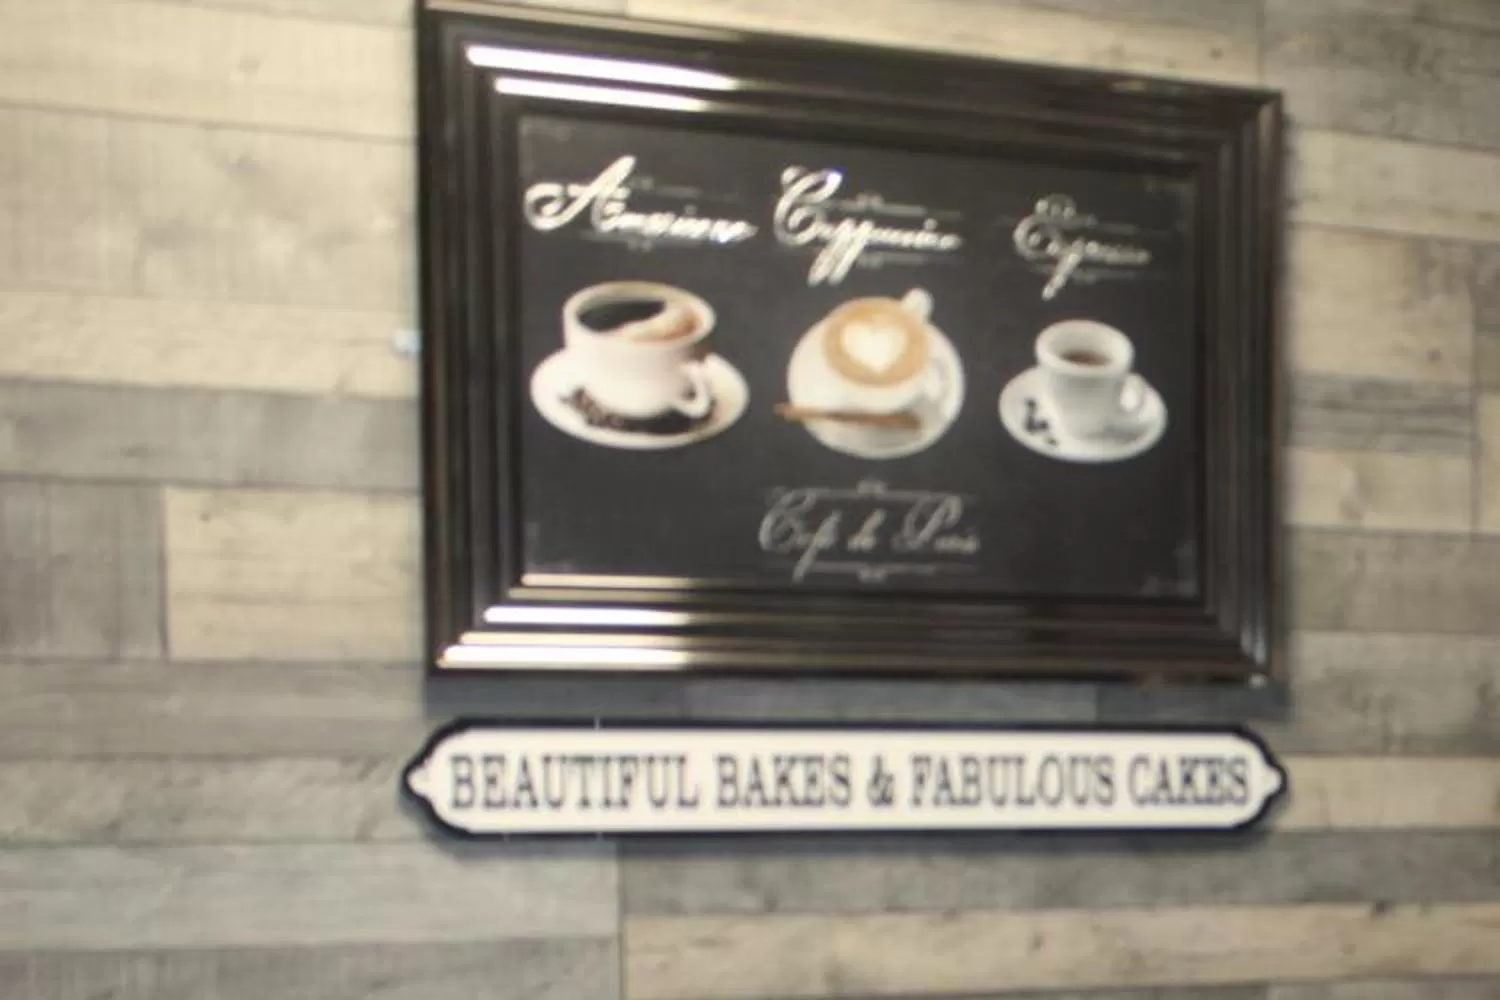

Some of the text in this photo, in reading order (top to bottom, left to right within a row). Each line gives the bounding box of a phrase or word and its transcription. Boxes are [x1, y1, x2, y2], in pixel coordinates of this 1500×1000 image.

[450, 755, 1250, 809] BEAUTIFUL BAKES & FABULOUS CAKES
